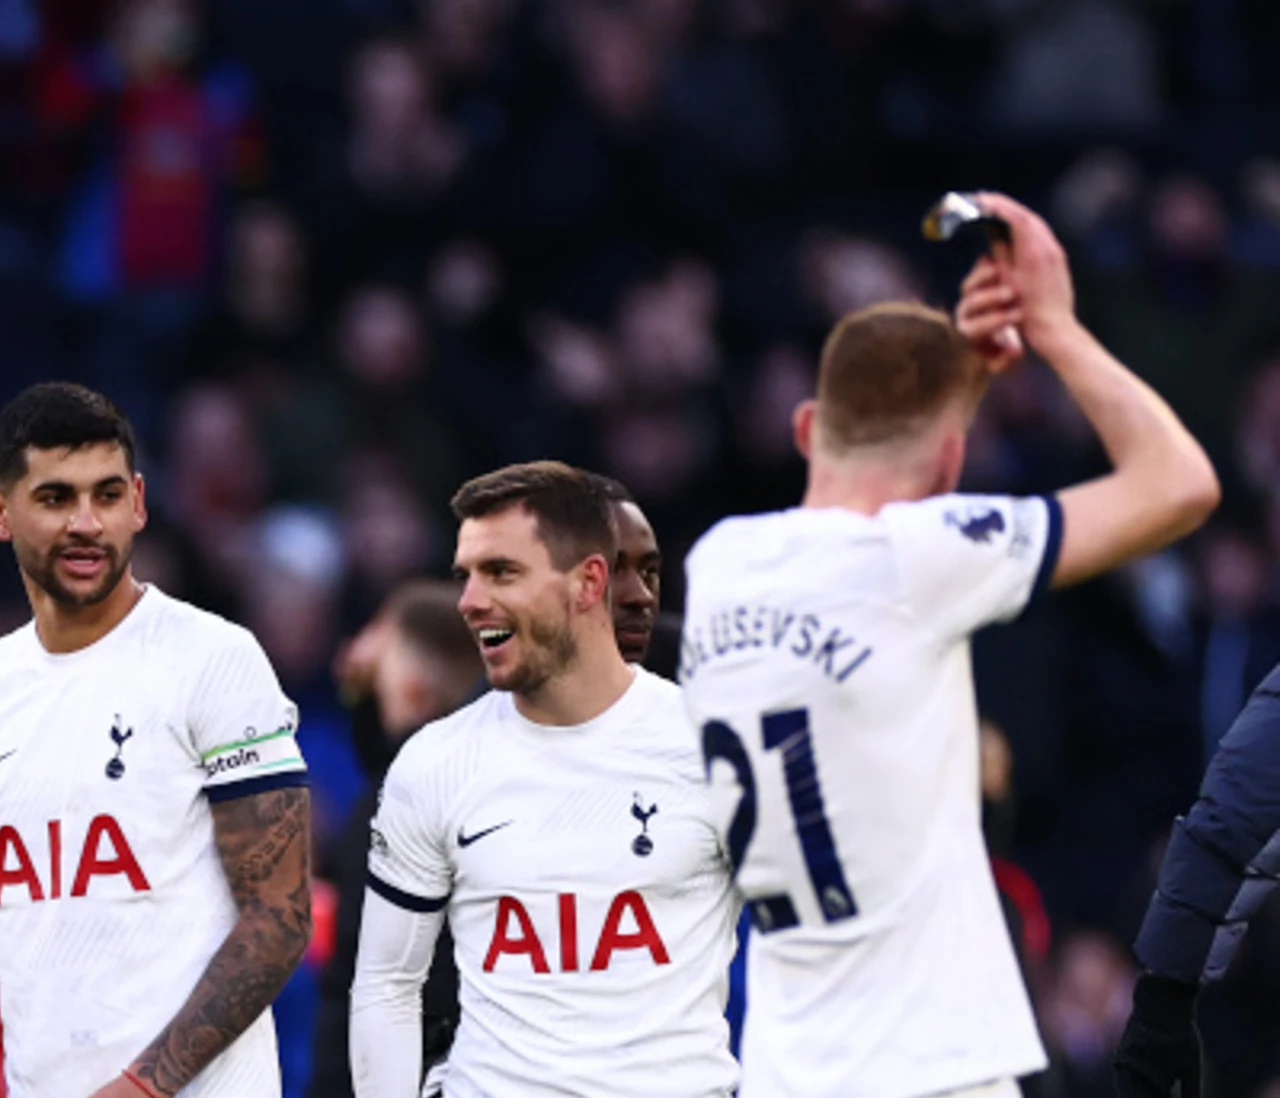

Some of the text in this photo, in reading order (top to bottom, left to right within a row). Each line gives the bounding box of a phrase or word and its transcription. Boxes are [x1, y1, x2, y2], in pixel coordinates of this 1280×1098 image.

[206, 748, 260, 780] ptain
[700, 706, 859, 936] 21
[482, 889, 671, 974] AIA
